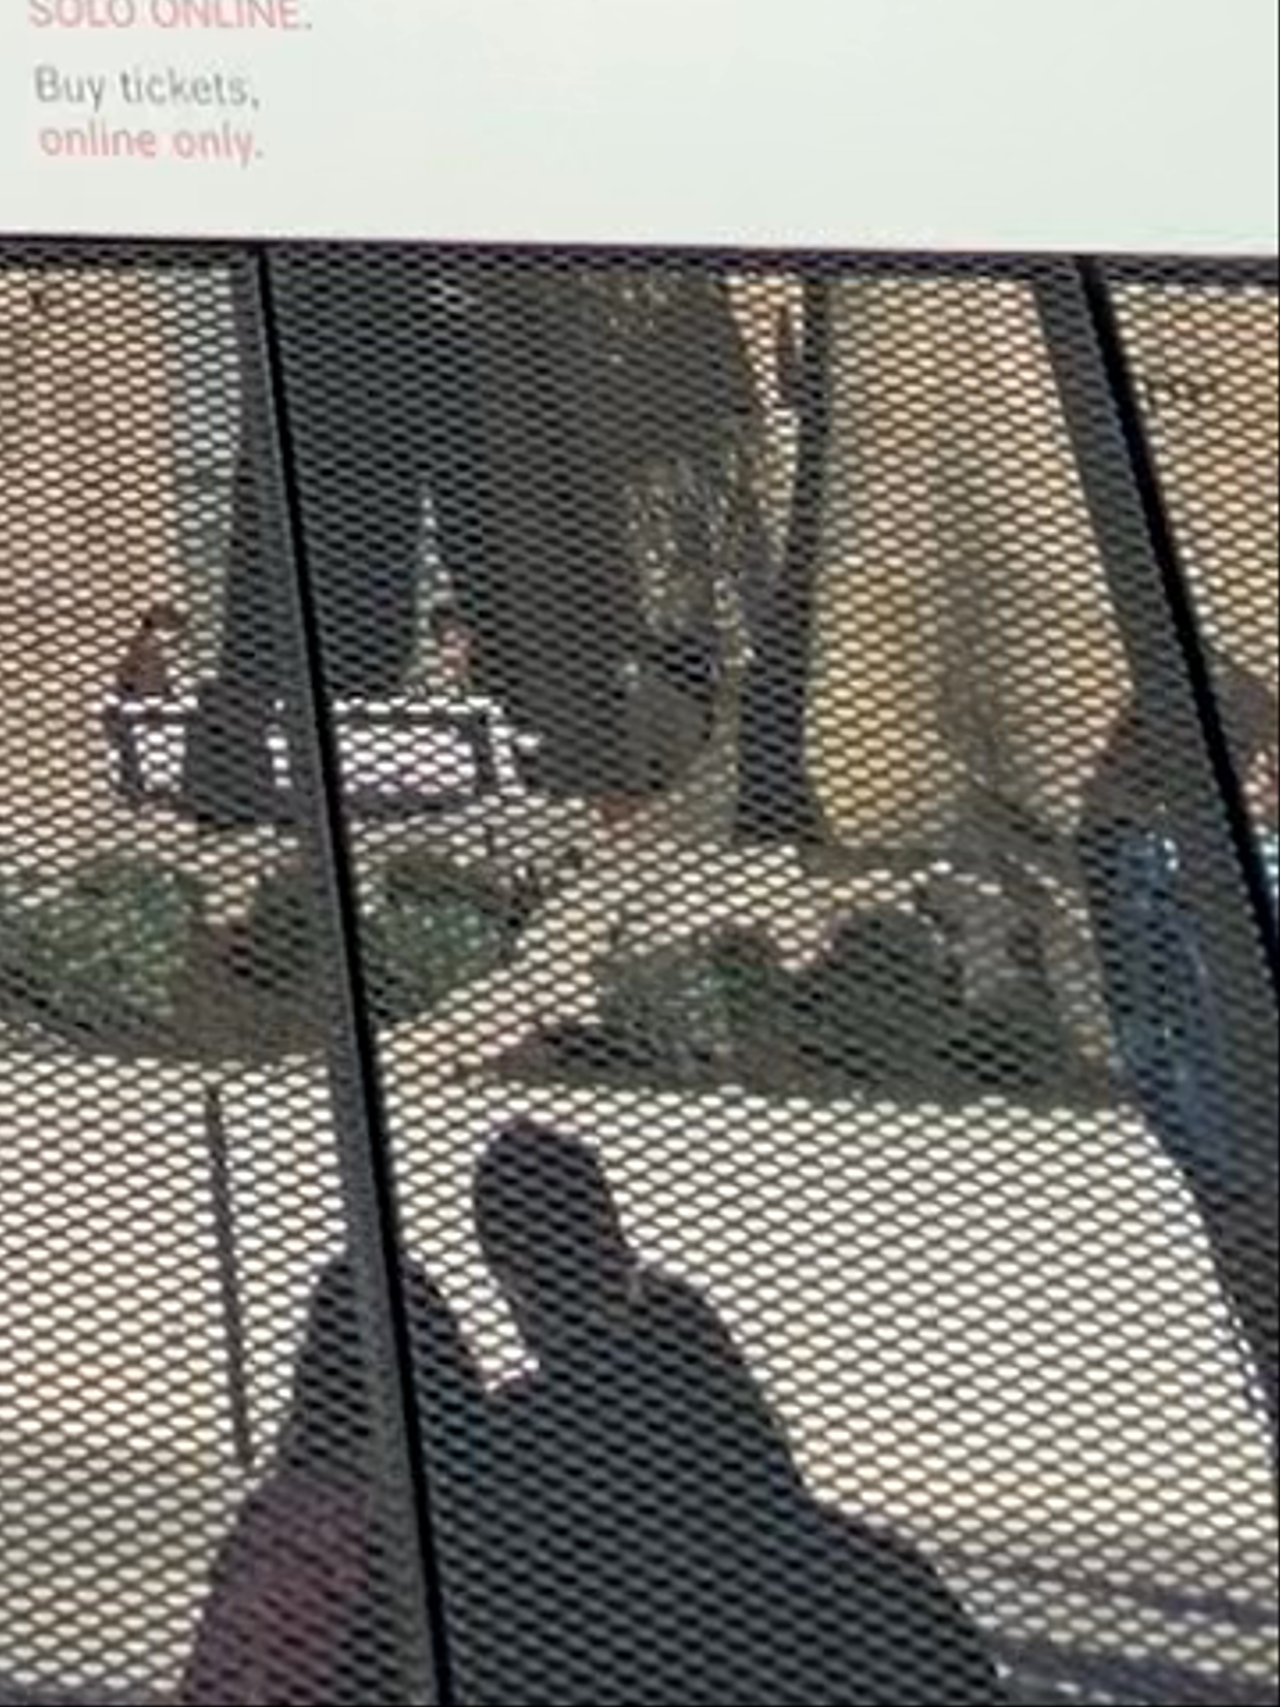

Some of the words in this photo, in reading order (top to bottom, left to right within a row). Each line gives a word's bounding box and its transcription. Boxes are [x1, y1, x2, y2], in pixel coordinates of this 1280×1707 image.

[34, 65, 106, 113] Buy
[119, 67, 260, 110] tickets,
[40, 120, 157, 158] online
[172, 121, 264, 169] only.
